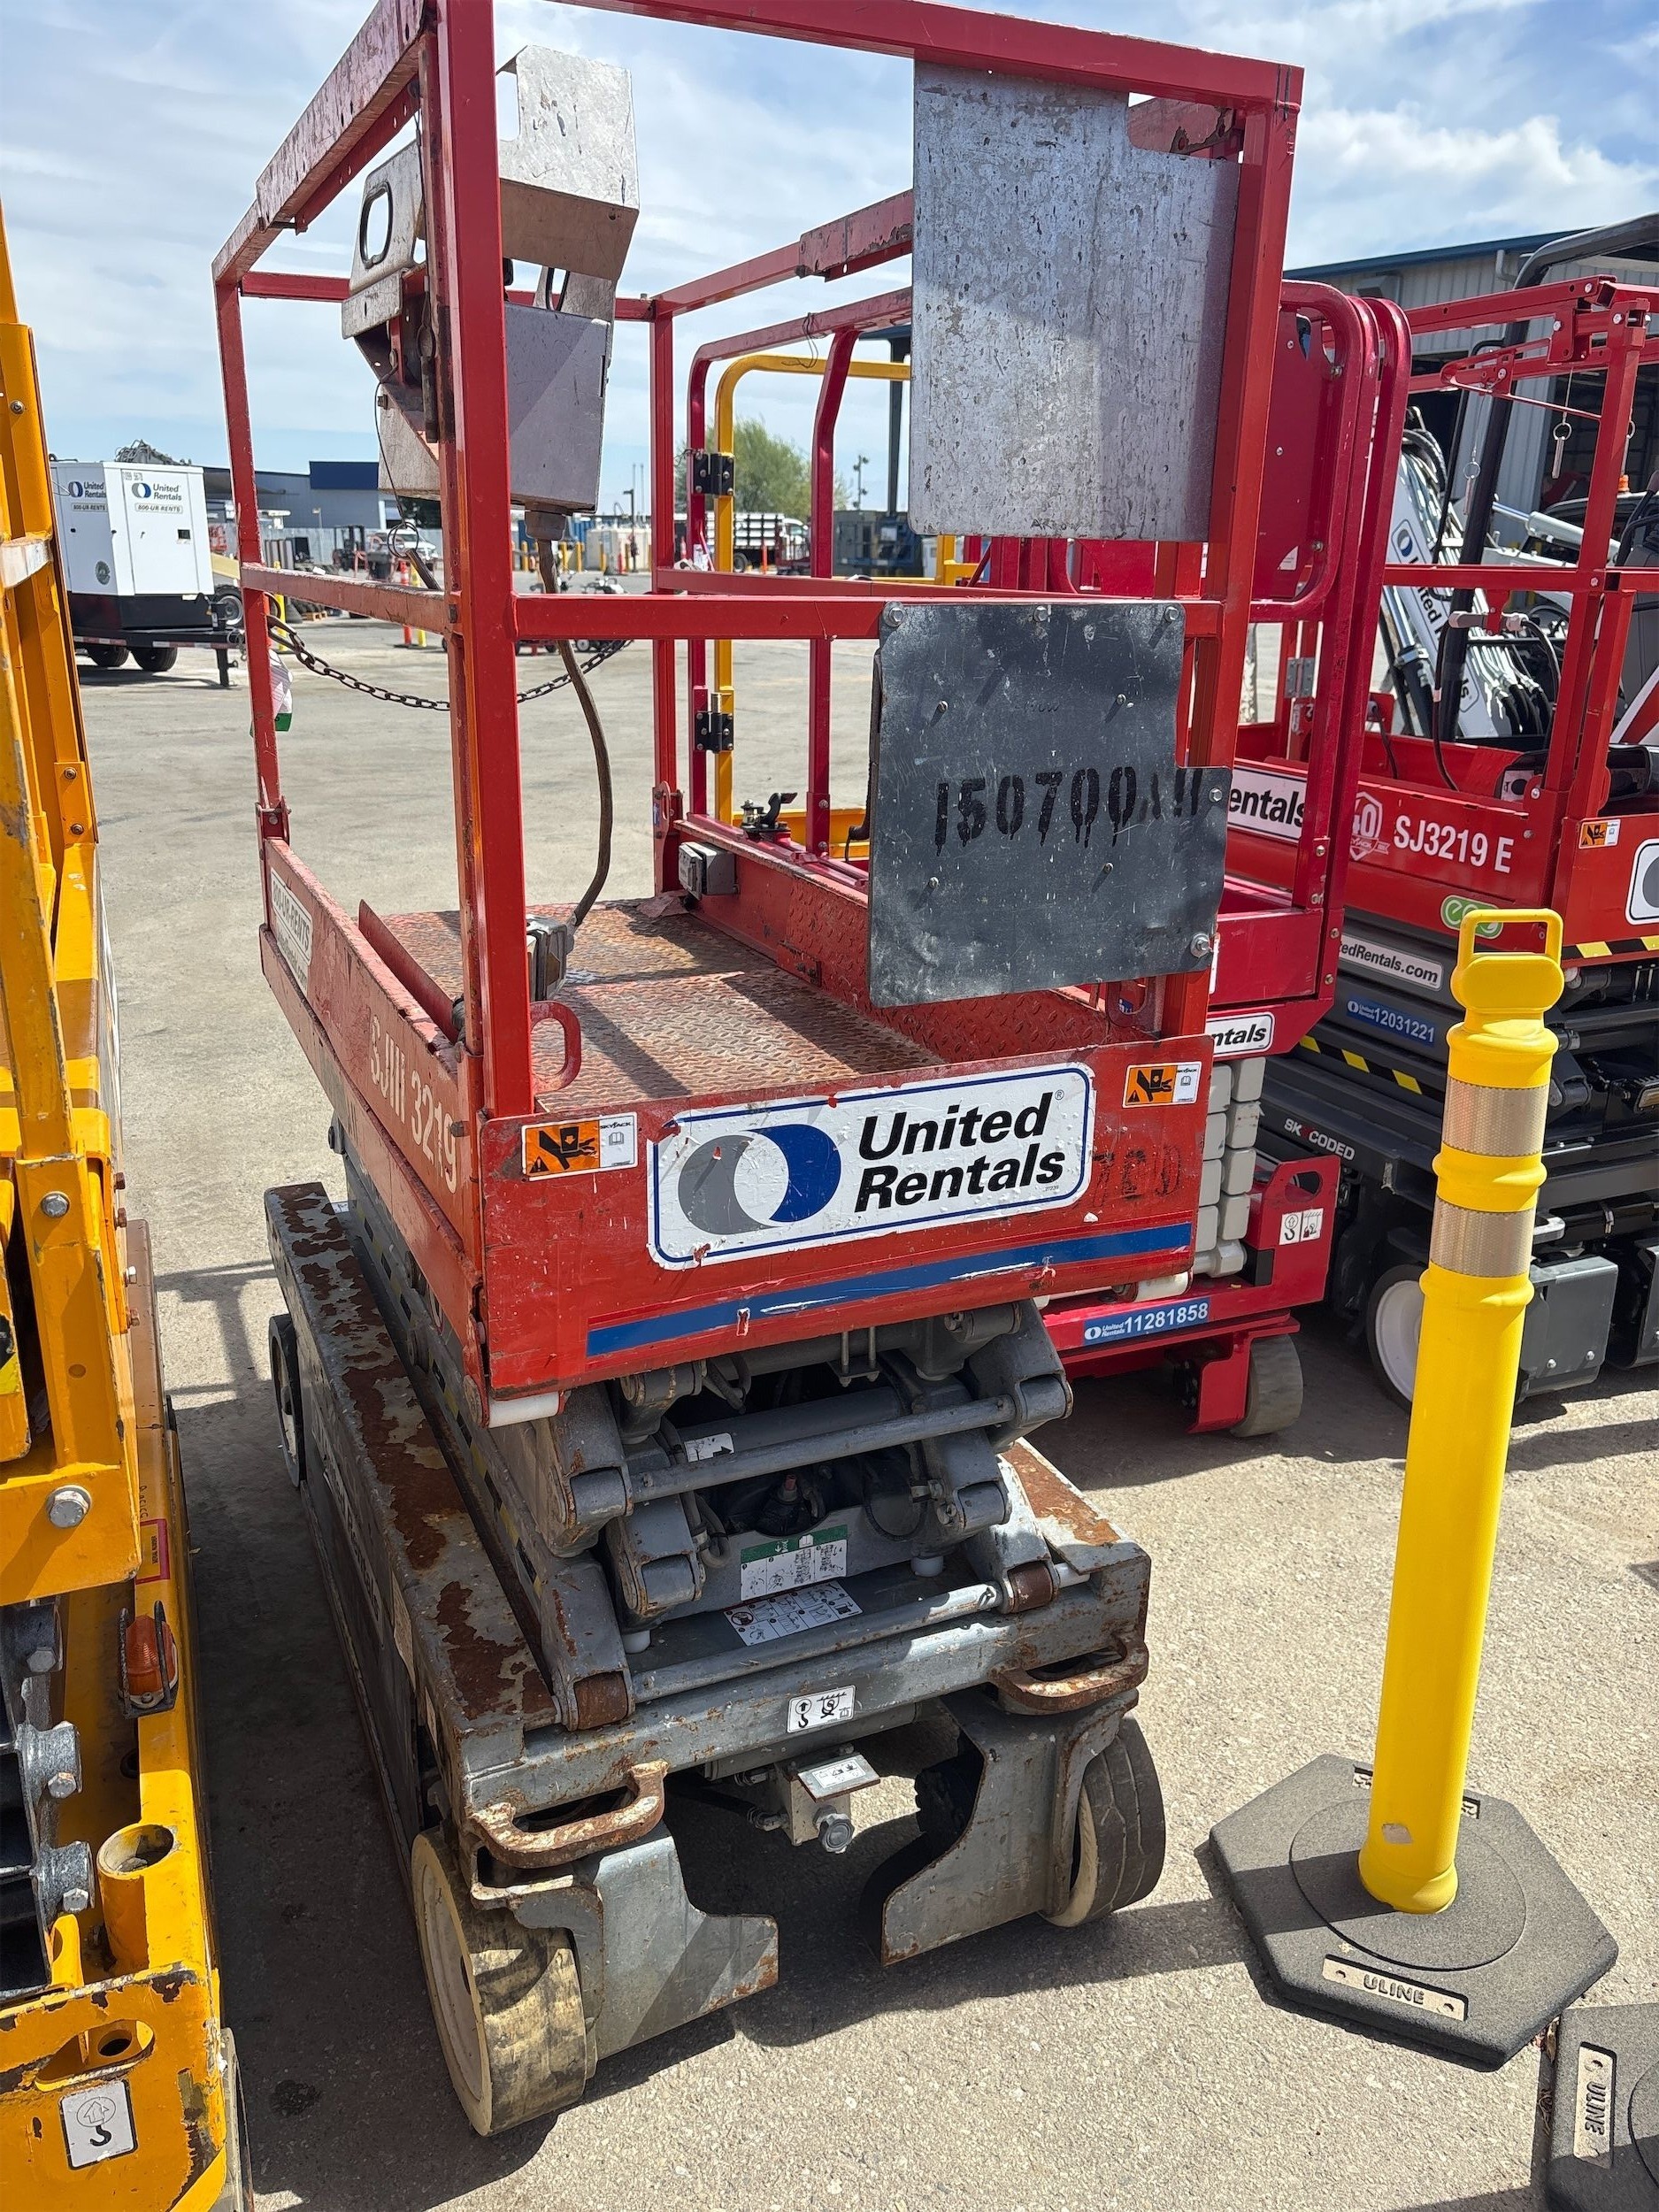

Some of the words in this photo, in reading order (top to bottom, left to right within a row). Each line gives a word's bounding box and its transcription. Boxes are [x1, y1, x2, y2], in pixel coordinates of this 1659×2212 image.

[84, 480, 104, 490] United
[153, 483, 179, 493] United
[154, 492, 181, 501] Rentals
[1394, 815, 1488, 867] SJ3219
[1494, 835, 1514, 873] E
[1374, 1007, 1434, 1042] 12031221
[411, 1069, 457, 1194] 3219
[858, 1092, 1054, 1160] United
[854, 1142, 1065, 1212] Rentals
[1102, 1322, 1125, 1332] United
[1125, 1302, 1209, 1333] 11281858
[1102, 1328, 1125, 1338] Rentals
[1363, 1974, 1425, 2005] ULINE
[1585, 2081, 1606, 2135] ULINE
